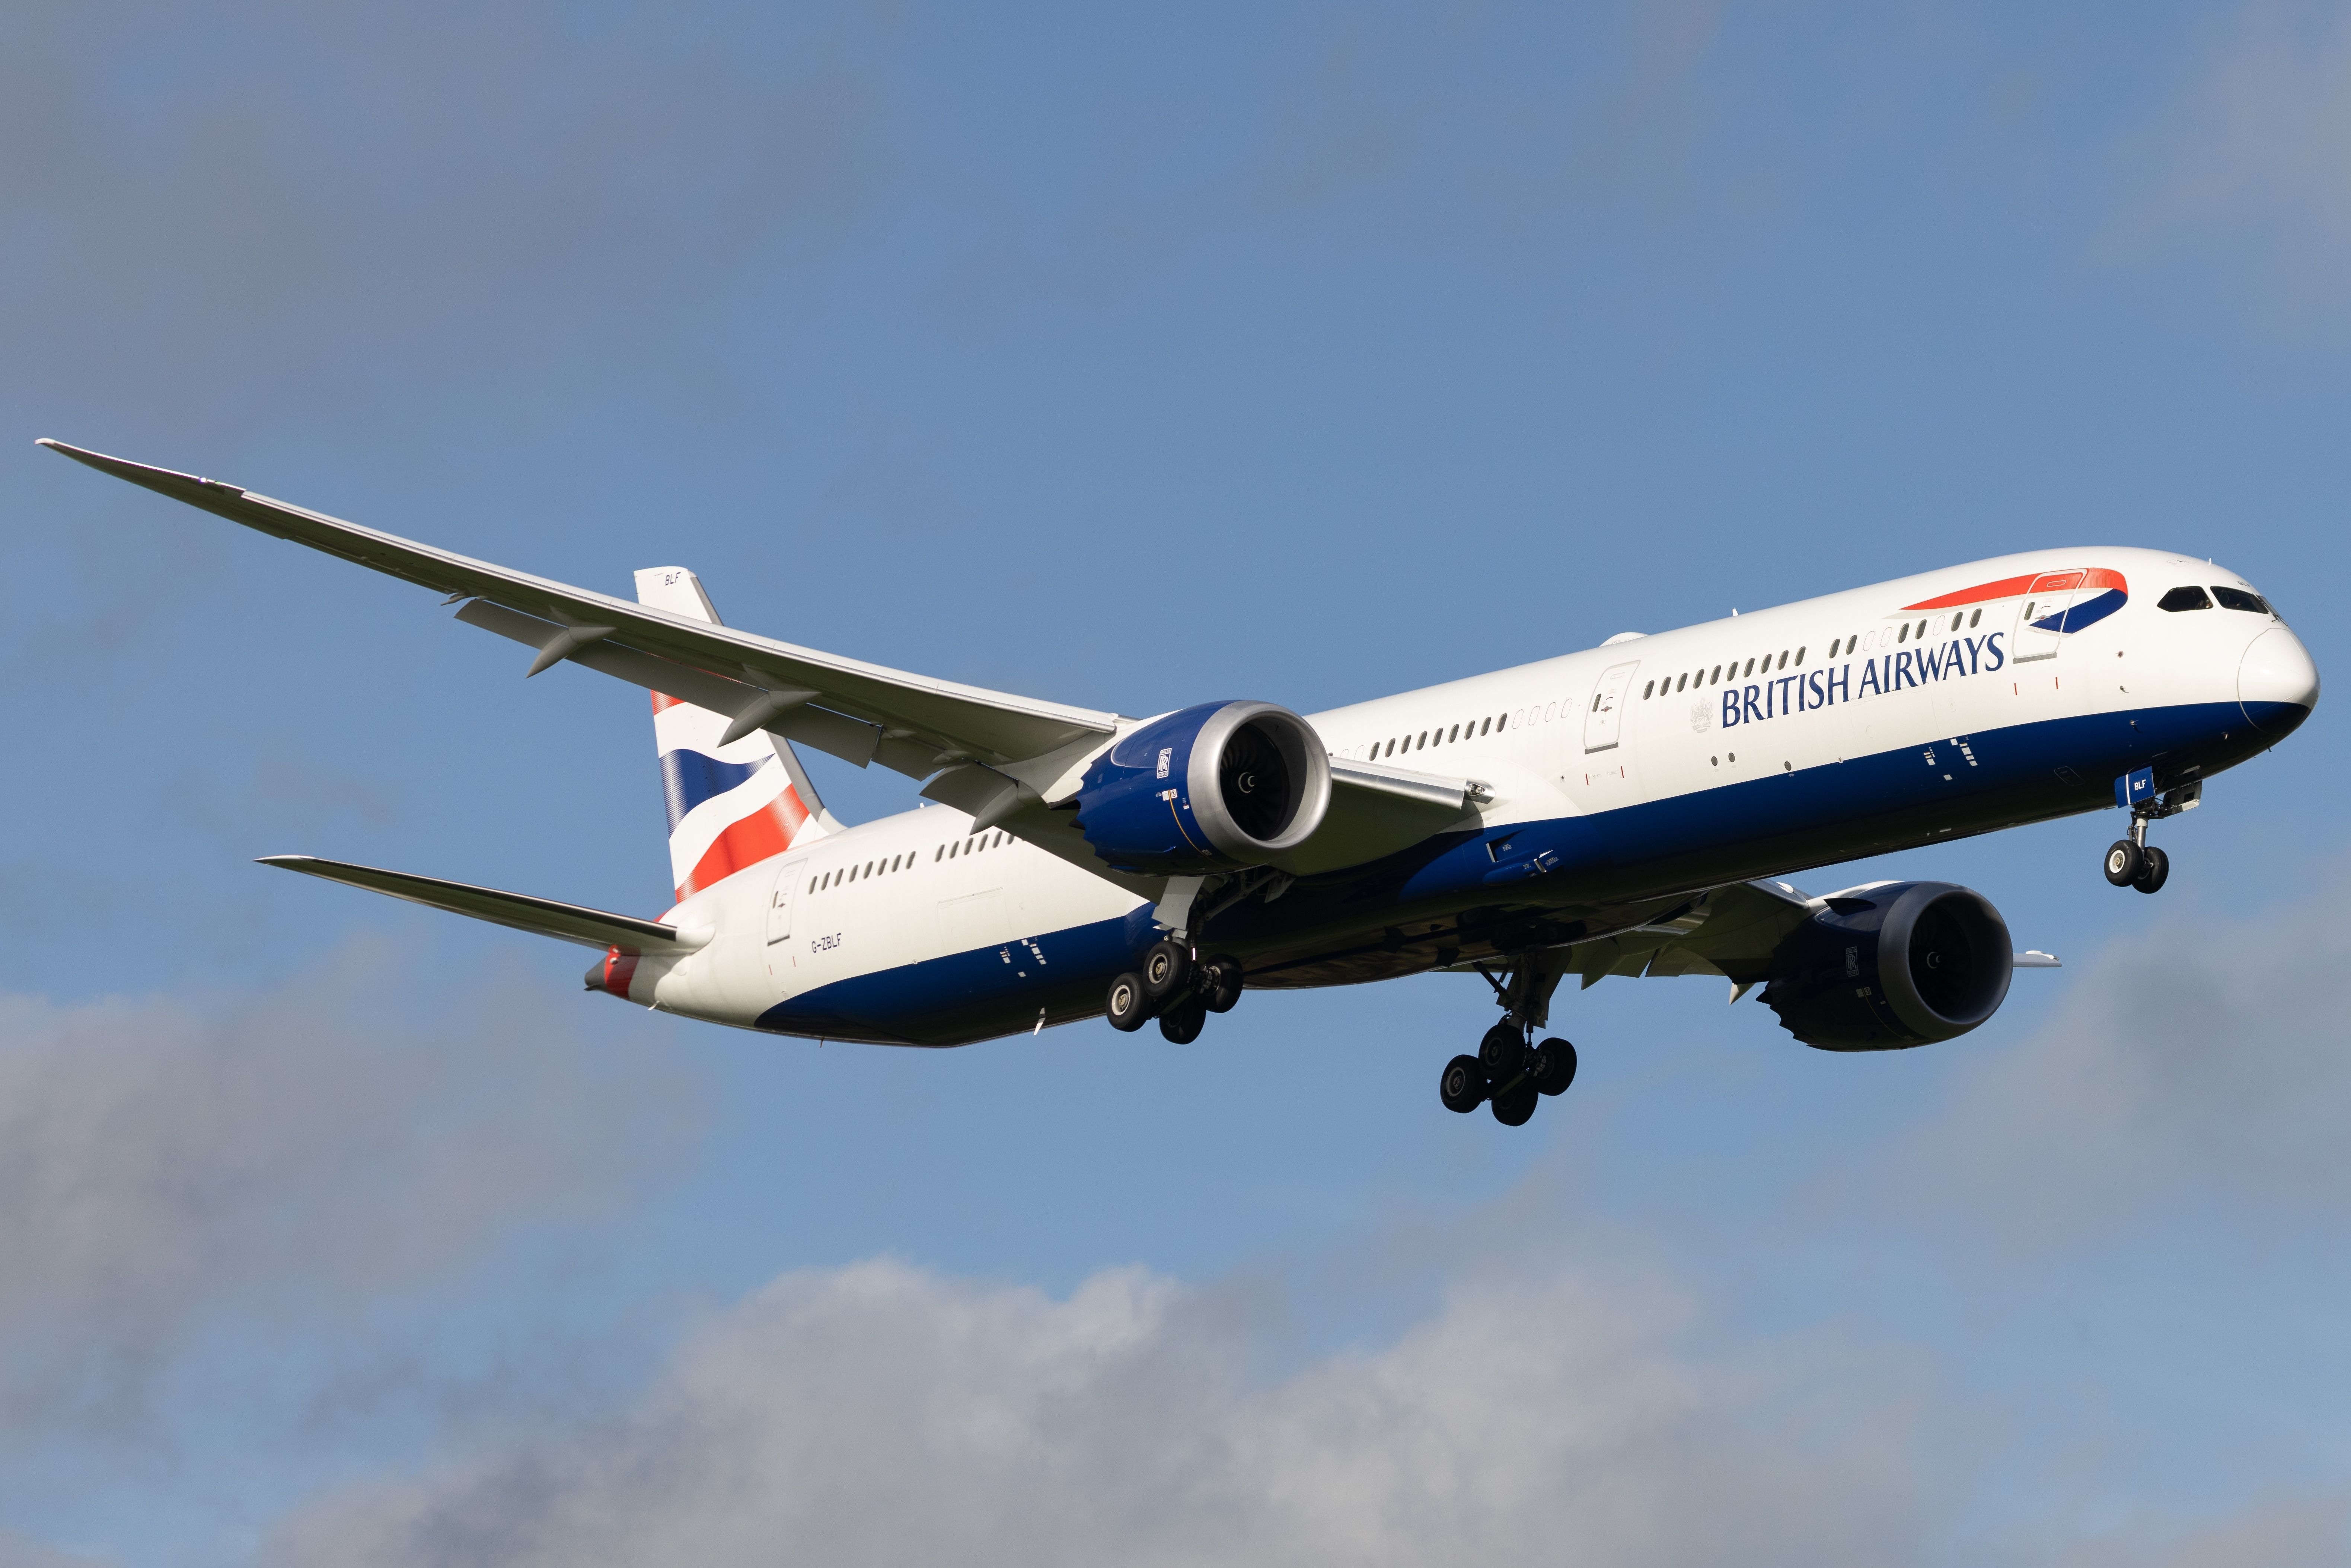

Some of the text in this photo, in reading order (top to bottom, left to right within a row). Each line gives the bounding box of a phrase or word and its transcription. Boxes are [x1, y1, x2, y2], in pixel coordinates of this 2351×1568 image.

[665, 572, 681, 586] BLF
[1722, 632, 2004, 728] BRITISH AIRWAYS
[2134, 779, 2146, 791] BLF
[812, 933, 841, 953] G-ZBLF
